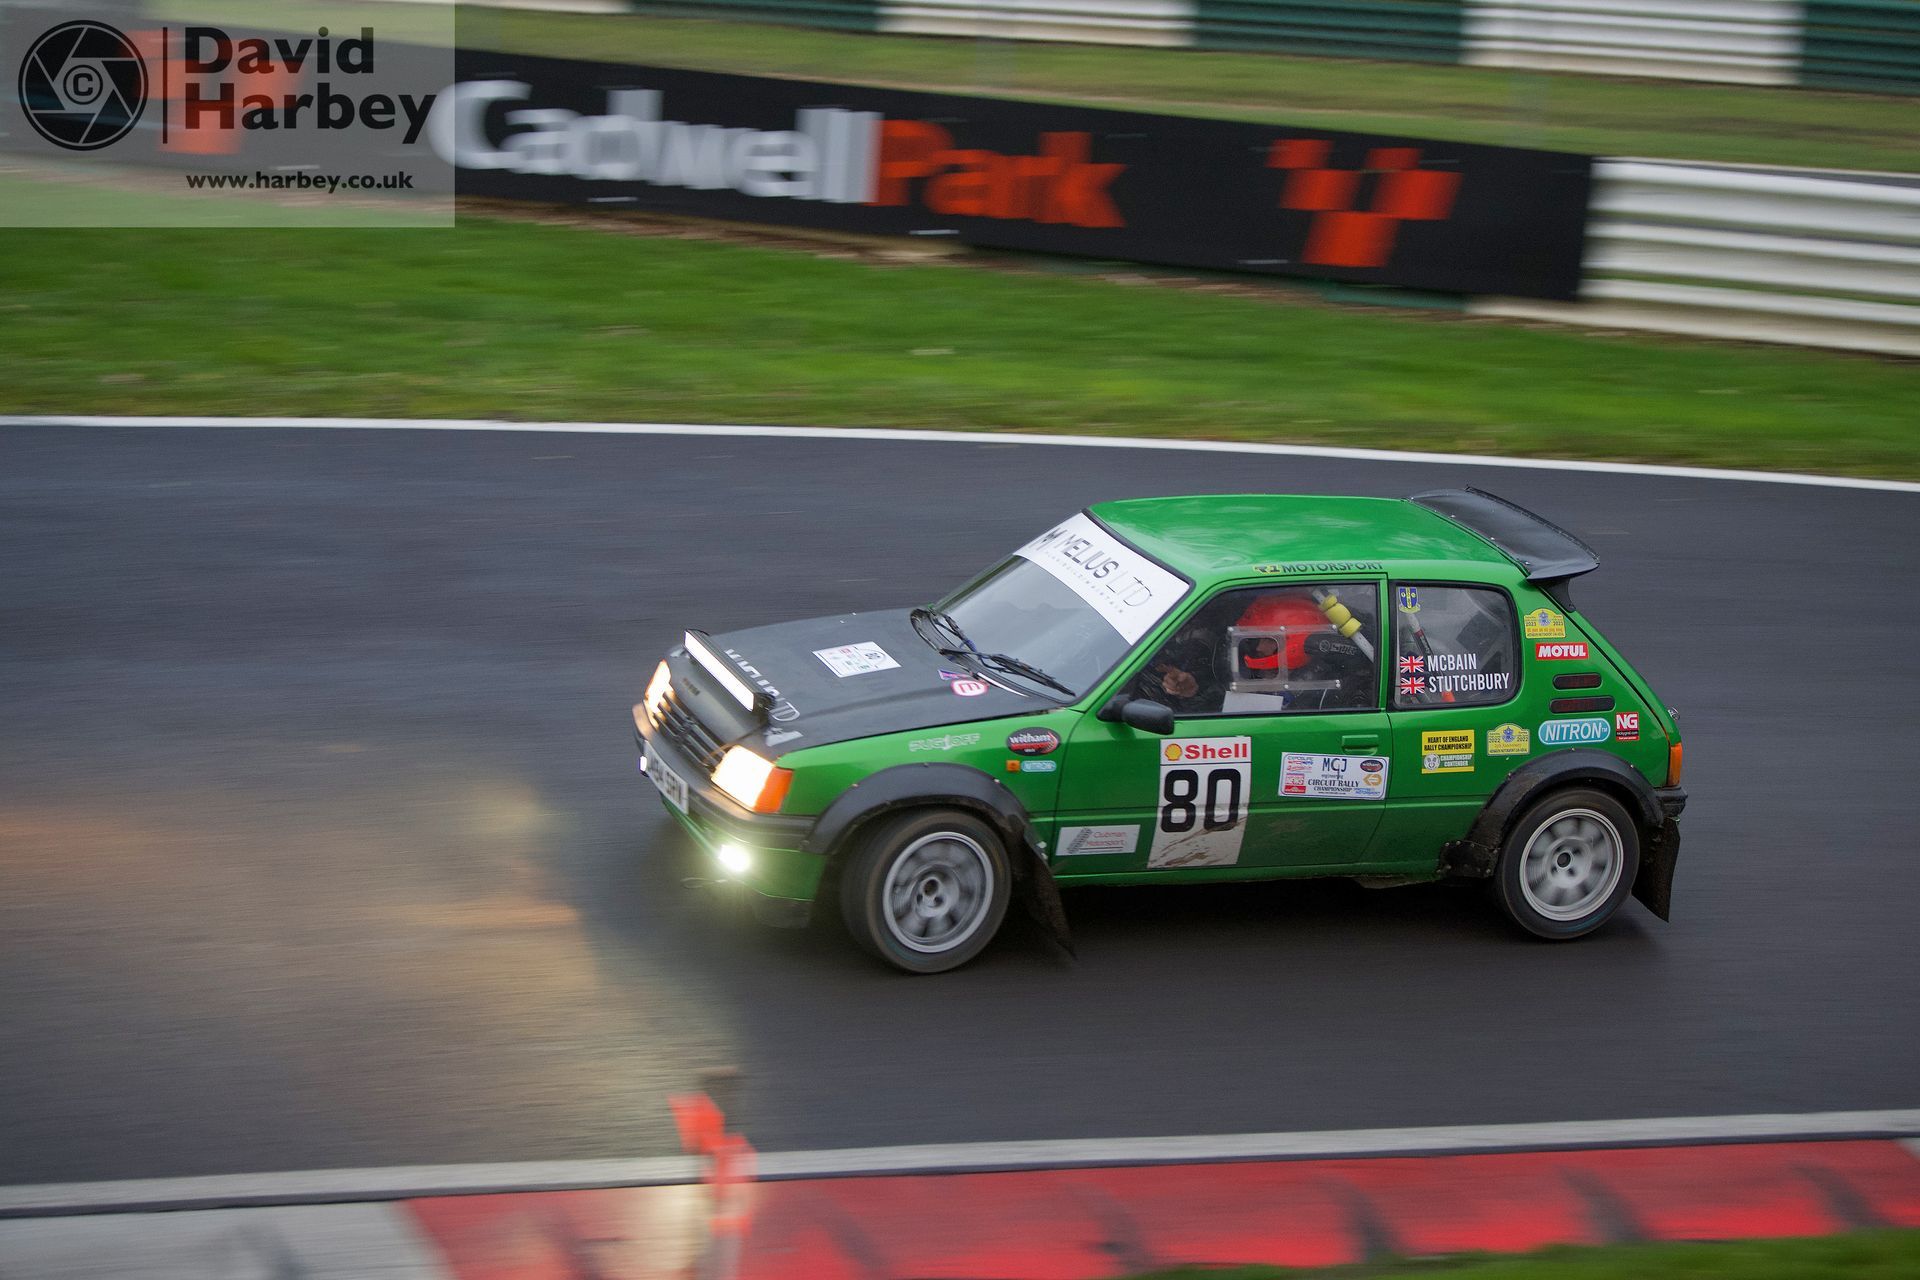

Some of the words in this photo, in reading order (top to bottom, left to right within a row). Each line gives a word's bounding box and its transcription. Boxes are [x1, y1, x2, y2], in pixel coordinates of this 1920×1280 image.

[1282, 561, 1384, 573] MOTORSPORT
[1538, 645, 1587, 657] MOTUL
[1427, 653, 1477, 672] MCBAIN
[1429, 673, 1510, 693] STUTCHBURY
[1616, 714, 1638, 729] NG
[1545, 722, 1602, 741] NITRON
[1185, 743, 1247, 759] Shell
[1307, 778, 1338, 787] CIRCUIT
[1338, 780, 1360, 788] RALLY
[1161, 768, 1241, 832] 80
